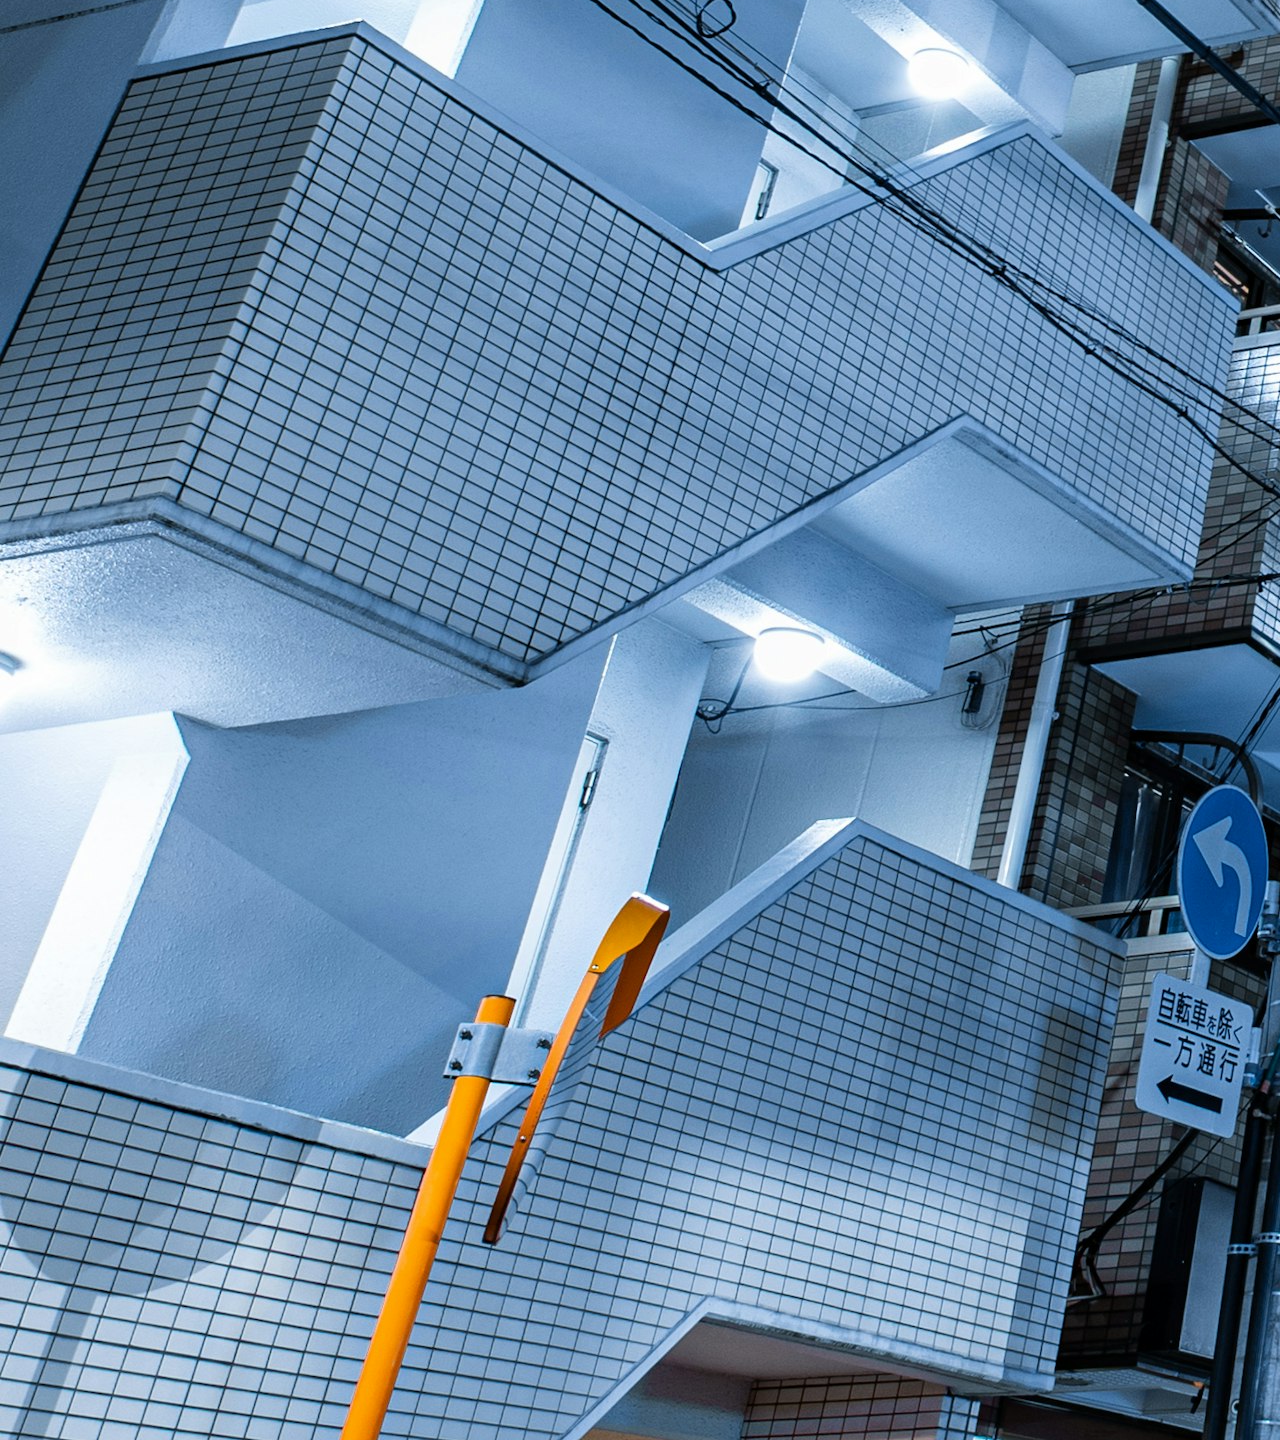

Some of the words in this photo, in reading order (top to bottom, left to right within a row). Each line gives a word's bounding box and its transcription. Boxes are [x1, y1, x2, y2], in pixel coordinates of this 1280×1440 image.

[1157, 987, 1243, 1044] 自転車を除く
[1153, 1036, 1239, 1084] 一方通行
